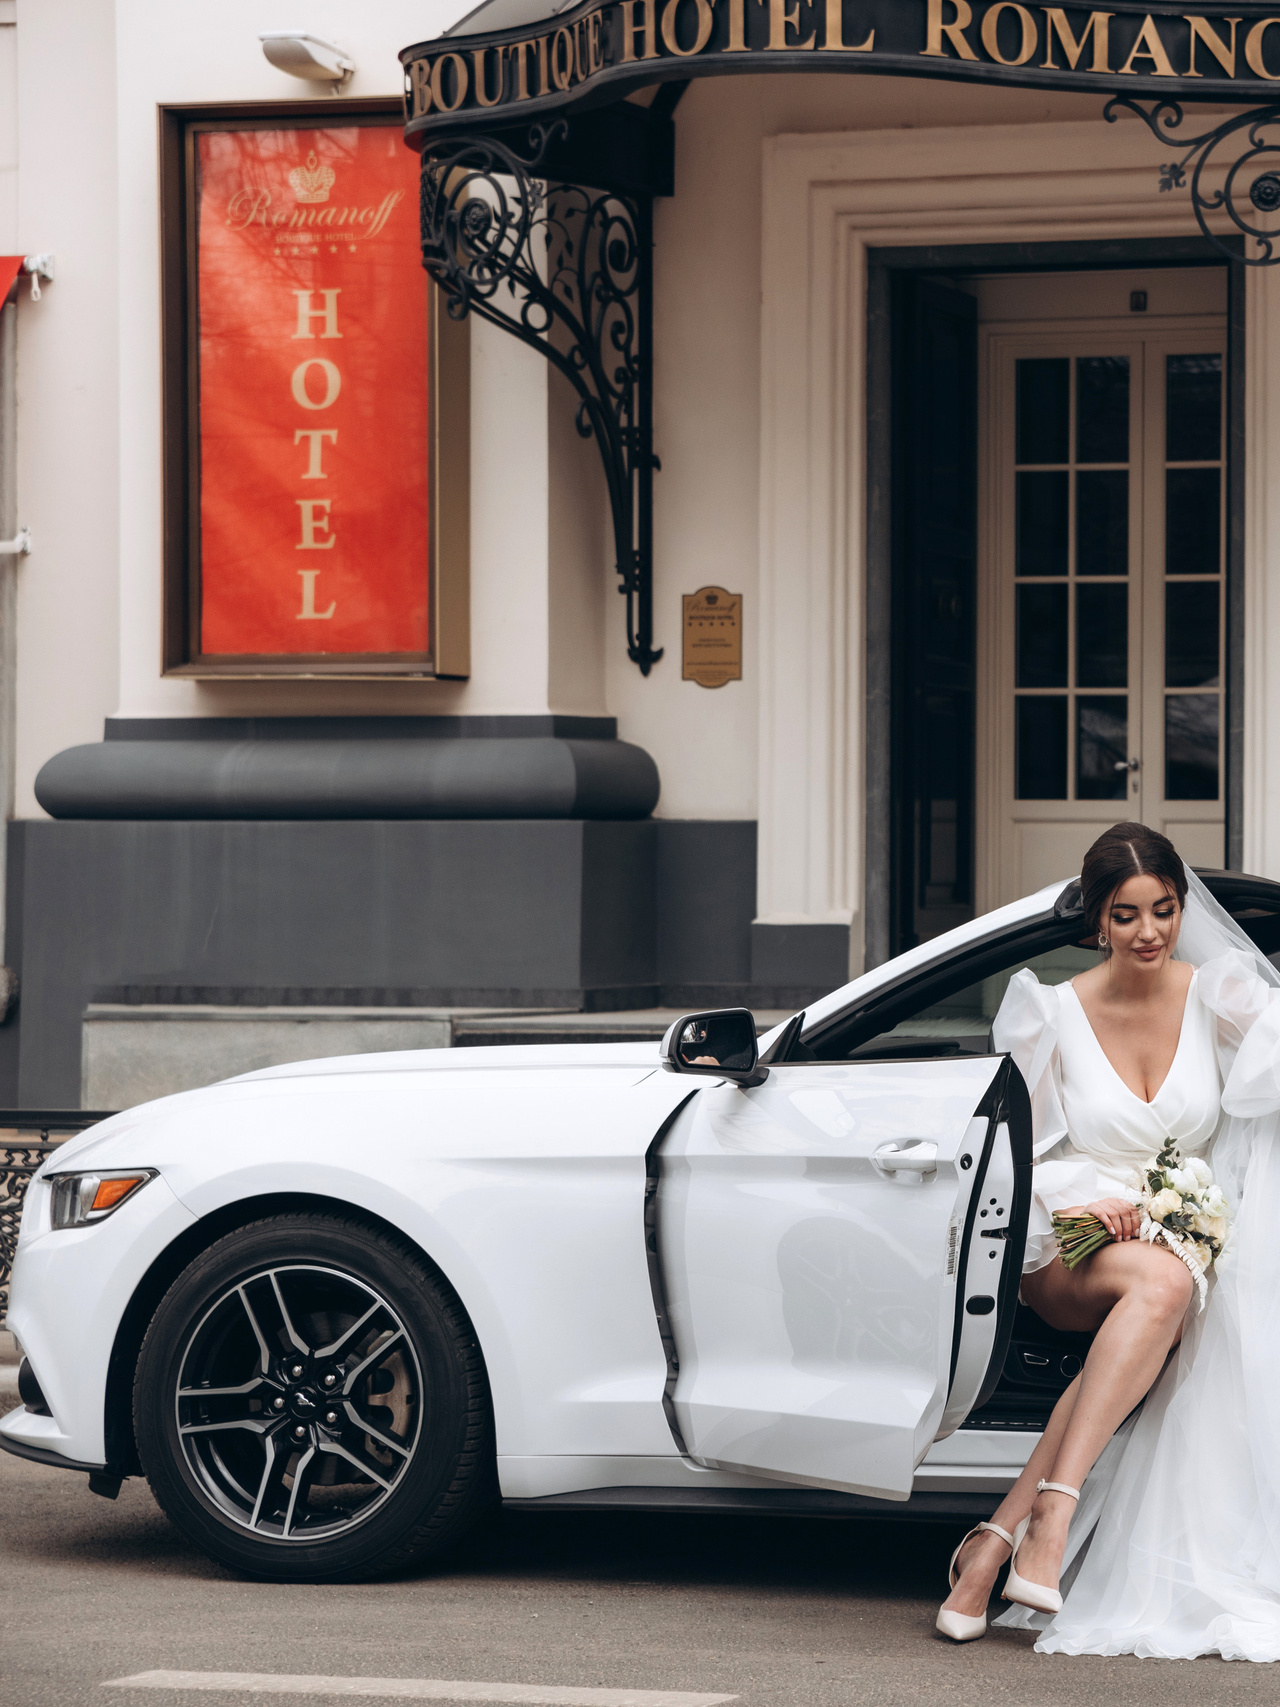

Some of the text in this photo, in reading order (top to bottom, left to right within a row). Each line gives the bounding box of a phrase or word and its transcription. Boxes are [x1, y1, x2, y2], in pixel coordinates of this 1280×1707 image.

[408, 8, 604, 119] BOUTIQUE
[619, 0, 876, 64] HOTEL
[225, 187, 406, 240] Romanoff
[291, 288, 343, 620] HOTEL
